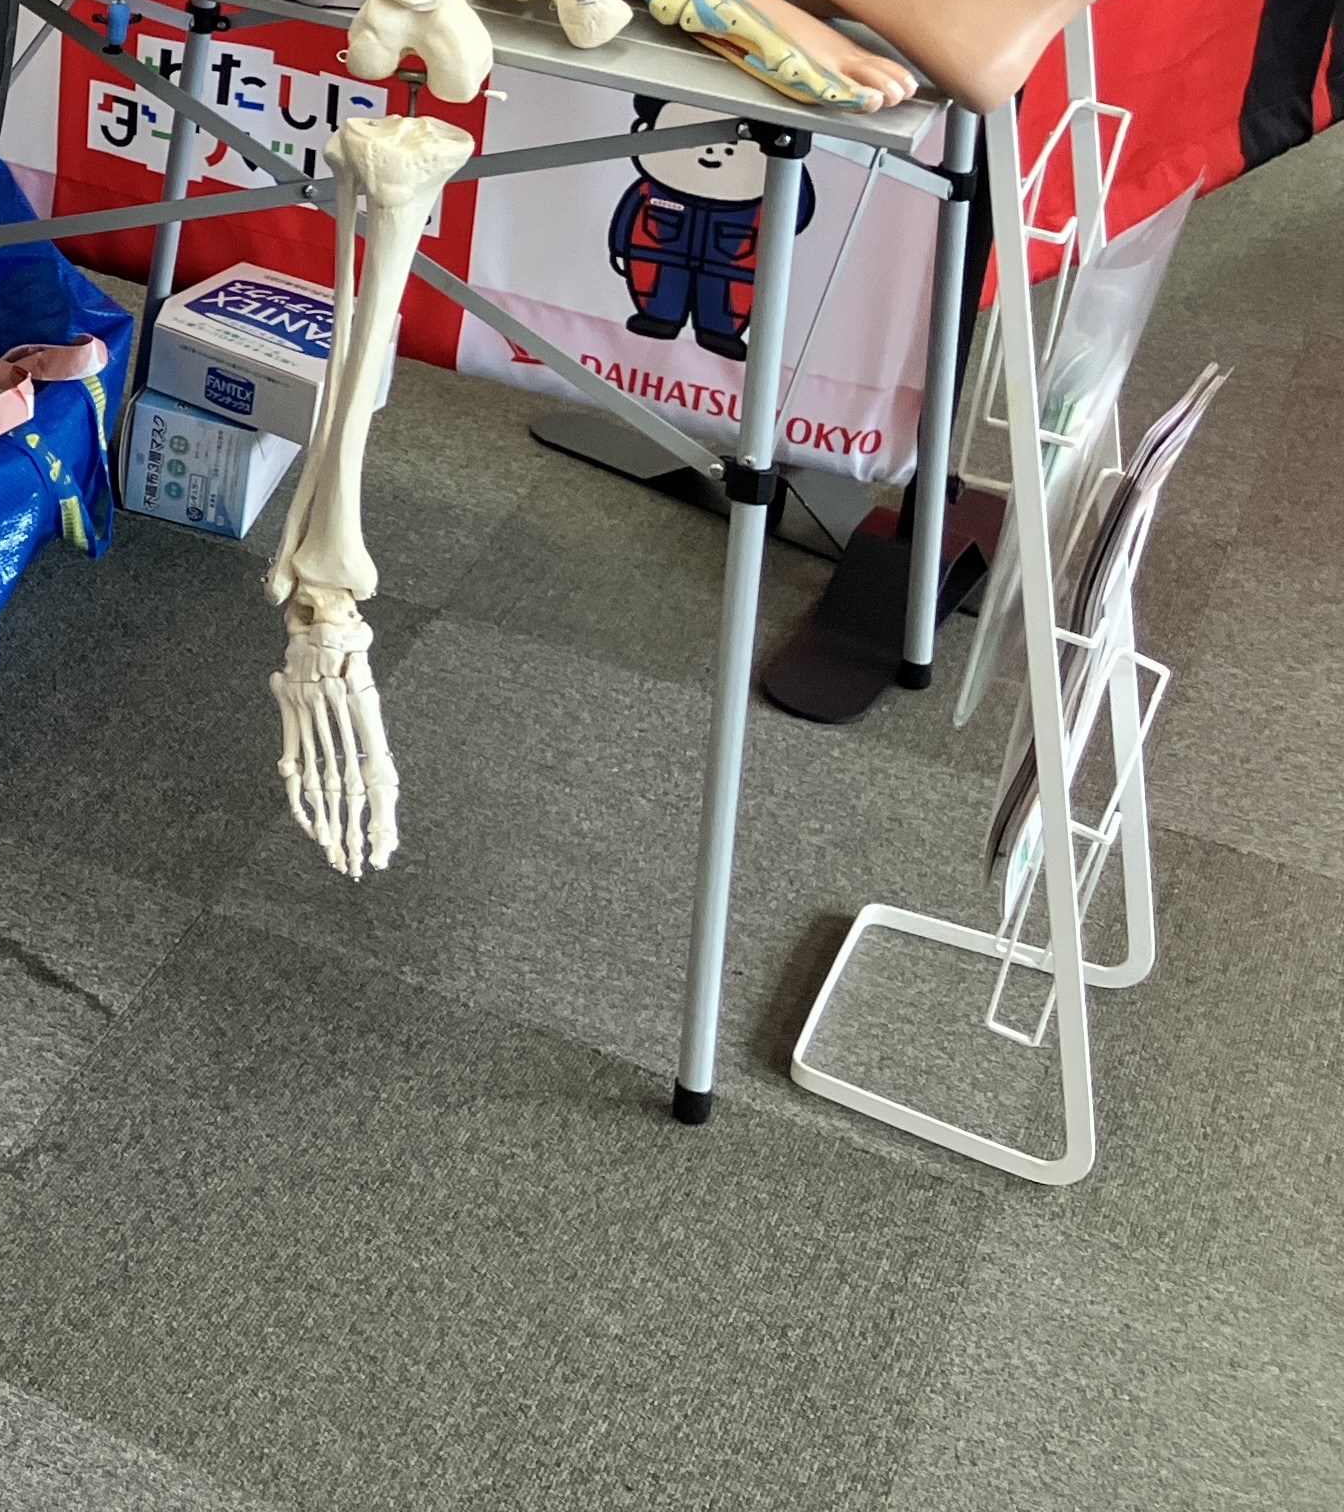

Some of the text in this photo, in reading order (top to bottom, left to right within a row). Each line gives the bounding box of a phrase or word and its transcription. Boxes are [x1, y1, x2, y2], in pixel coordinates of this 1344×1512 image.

[228, 282, 333, 324] ンテックス
[206, 377, 254, 402] FANTEX
[786, 417, 882, 455] OKYO
